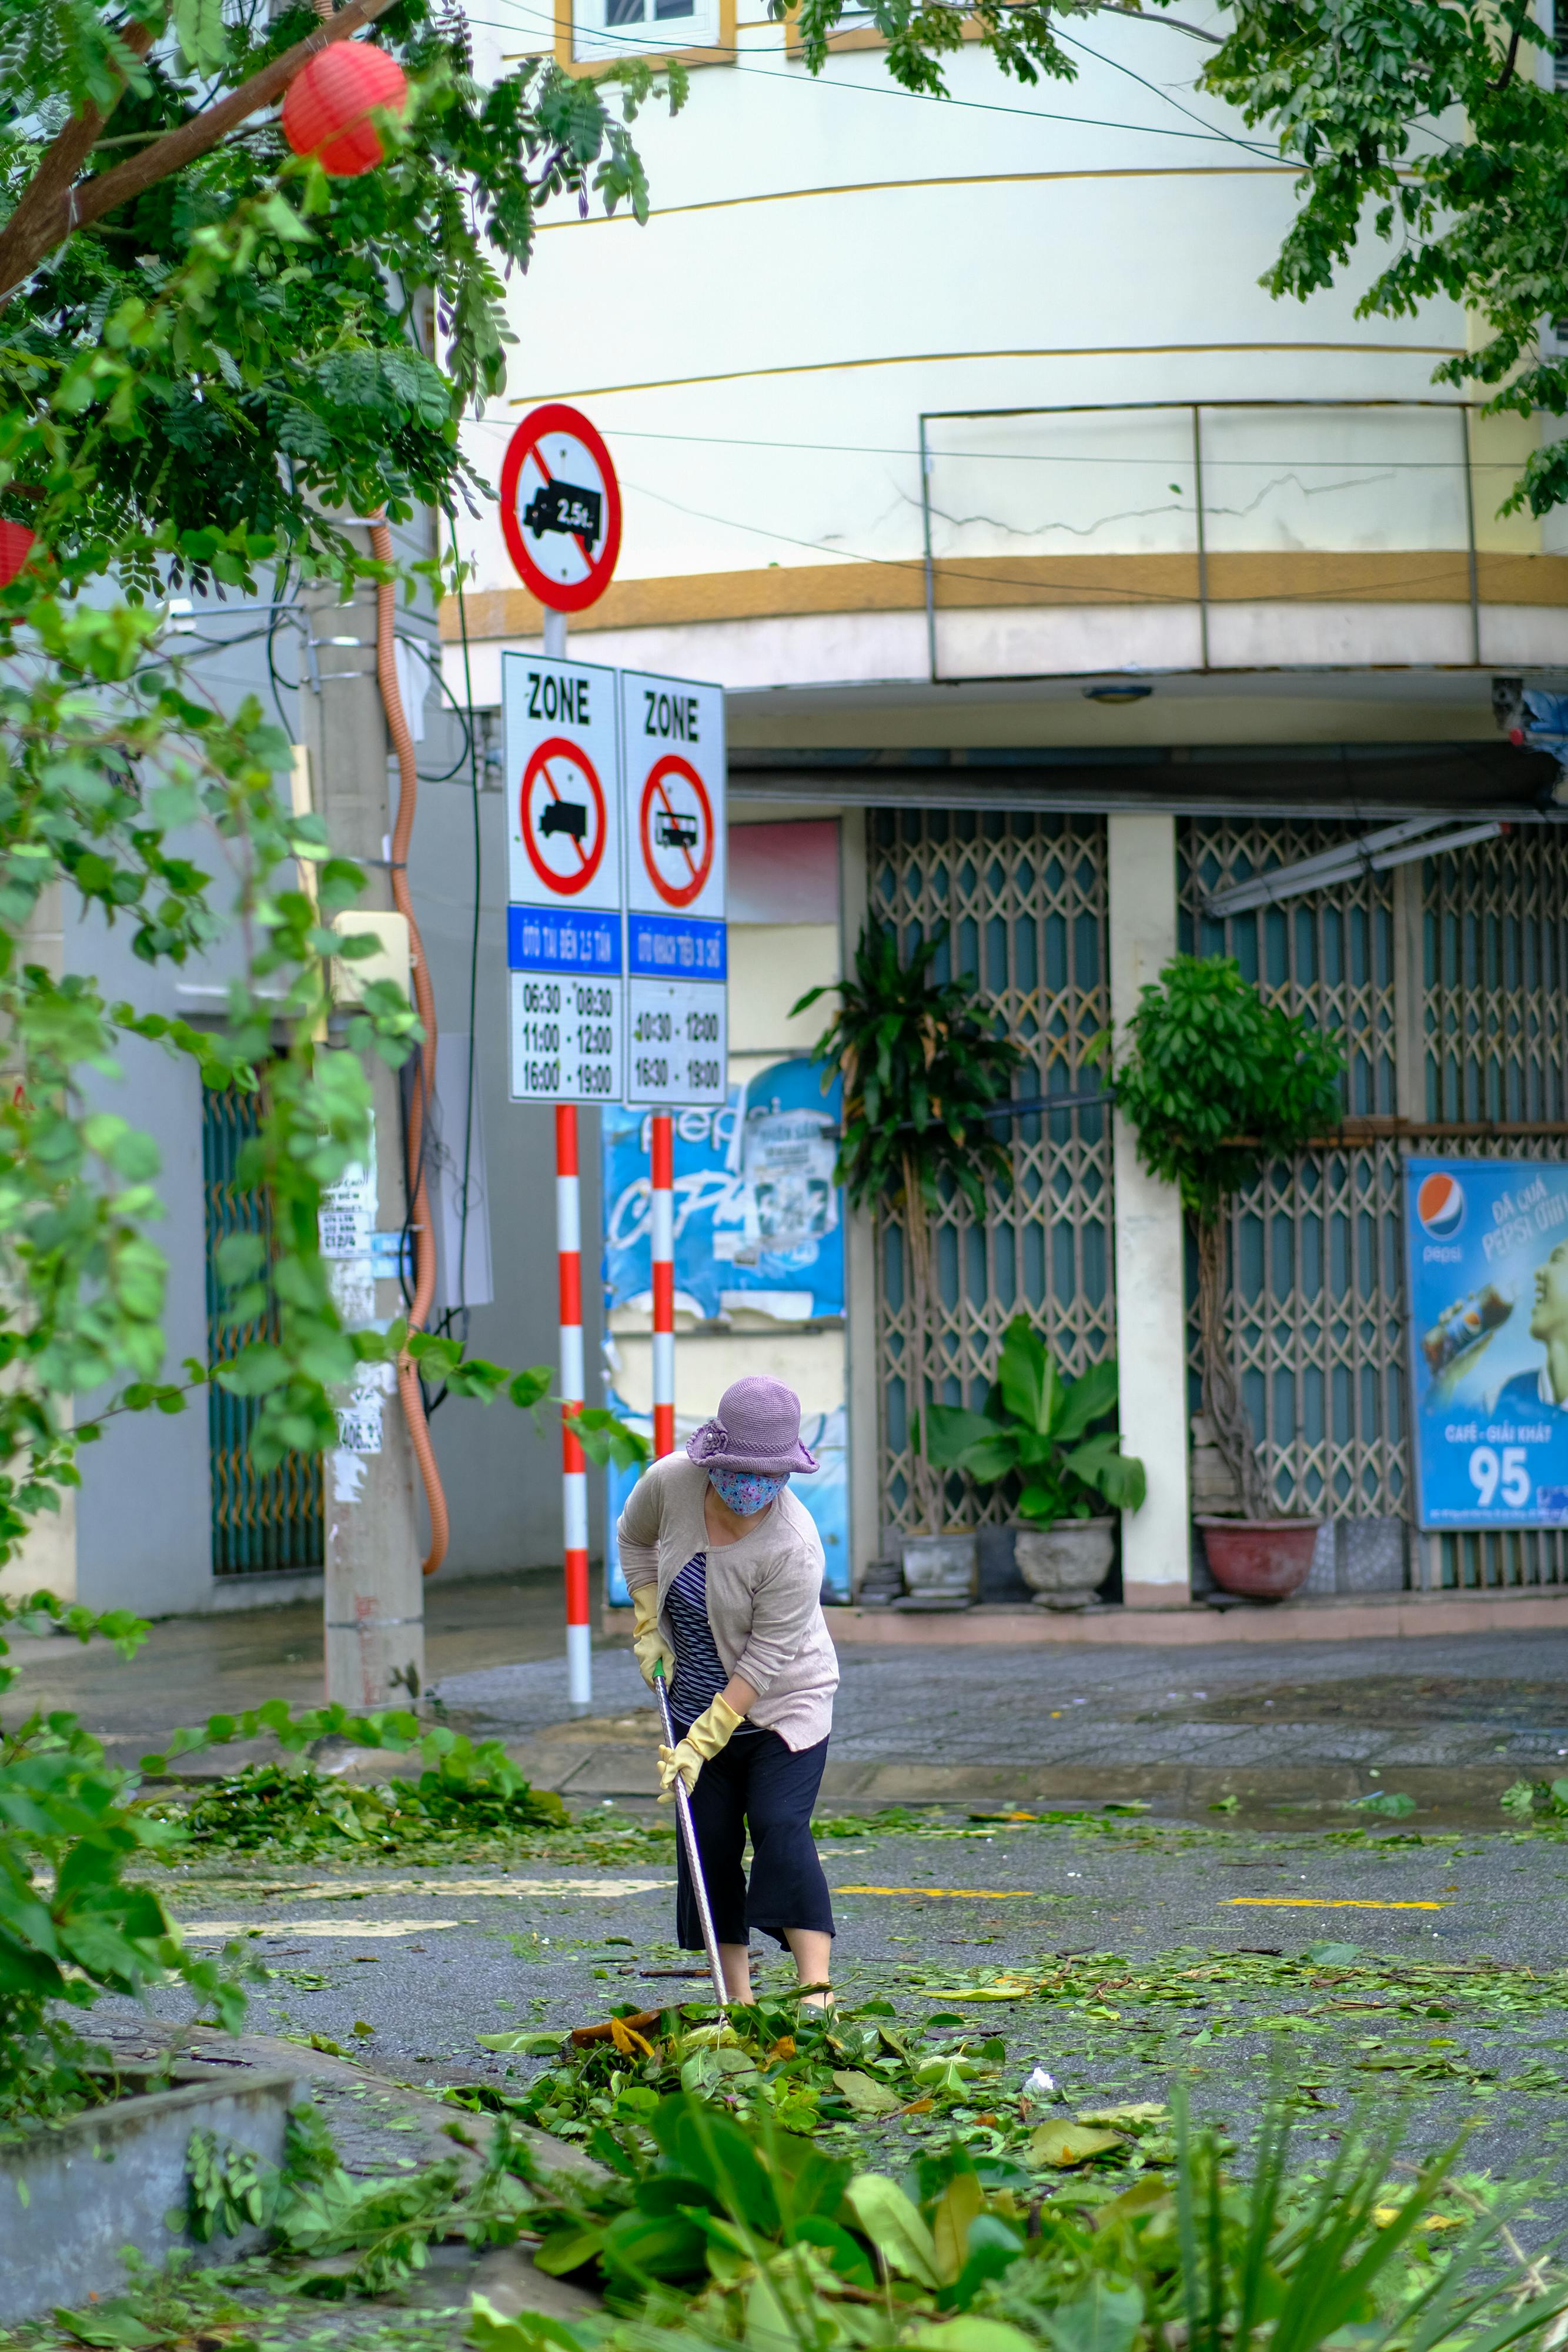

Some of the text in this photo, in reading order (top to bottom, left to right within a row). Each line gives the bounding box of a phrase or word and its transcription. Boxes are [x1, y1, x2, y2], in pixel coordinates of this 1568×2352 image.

[527, 673, 590, 725] ZONE
[644, 691, 699, 742] ZONE
[523, 984, 560, 1014] 06:30
[577, 987, 612, 1017] 08:30
[523, 1022, 560, 1053] 11:00
[577, 1024, 612, 1055] 12:00
[637, 1012, 671, 1042] 10:30
[687, 1013, 718, 1042] 12:00
[524, 1061, 560, 1091] 16:00
[577, 1064, 612, 1094] 19:00
[1423, 1245, 1462, 1264] pepsi
[1482, 1215, 1532, 1261] PEPSI
[1445, 1421, 1477, 1443] CAFÉ
[1469, 1445, 1530, 1507] 95
